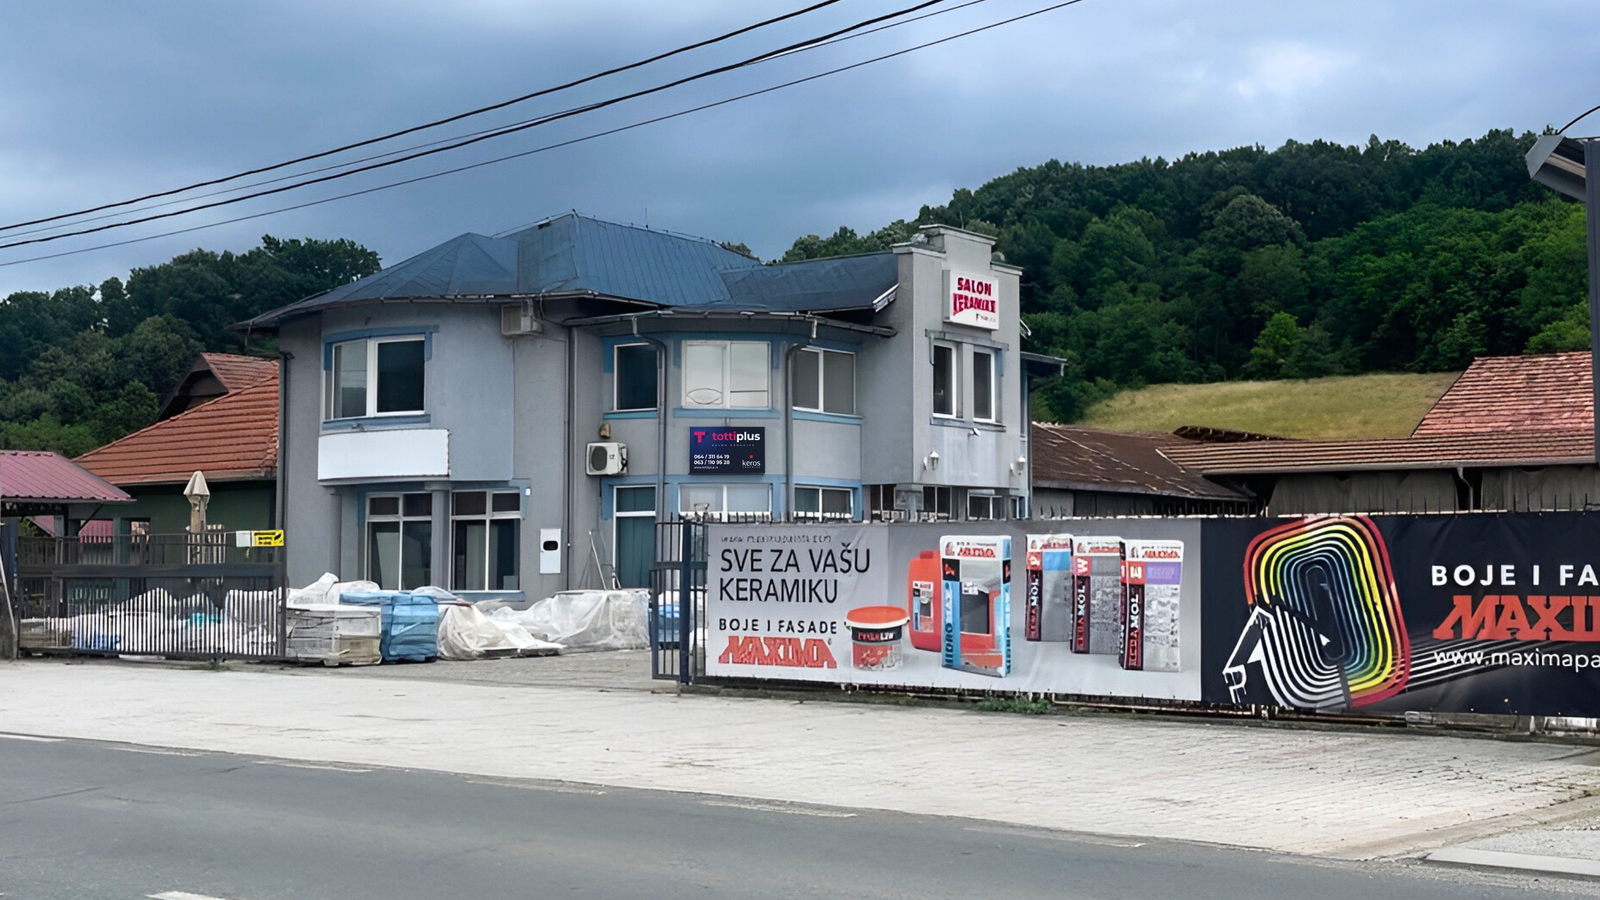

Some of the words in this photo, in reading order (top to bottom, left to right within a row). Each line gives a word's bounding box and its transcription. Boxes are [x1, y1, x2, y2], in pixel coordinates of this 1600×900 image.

[957, 277, 992, 297] SALON
[712, 431, 761, 443] tottiplus
[742, 459, 761, 467] keros
[720, 548, 763, 573] SVE
[770, 548, 801, 573] ZA
[808, 542, 871, 574] VAŠU
[1431, 564, 1516, 587] BOJE
[1532, 564, 1541, 586] I
[1559, 564, 1600, 586] FA
[719, 577, 838, 604] KERAMIKU
[719, 618, 760, 632] BOJE
[766, 619, 771, 632] I
[778, 620, 838, 634] FASADE
[1432, 594, 1600, 642] MAXI
[1433, 648, 1600, 673] www.maximapa
